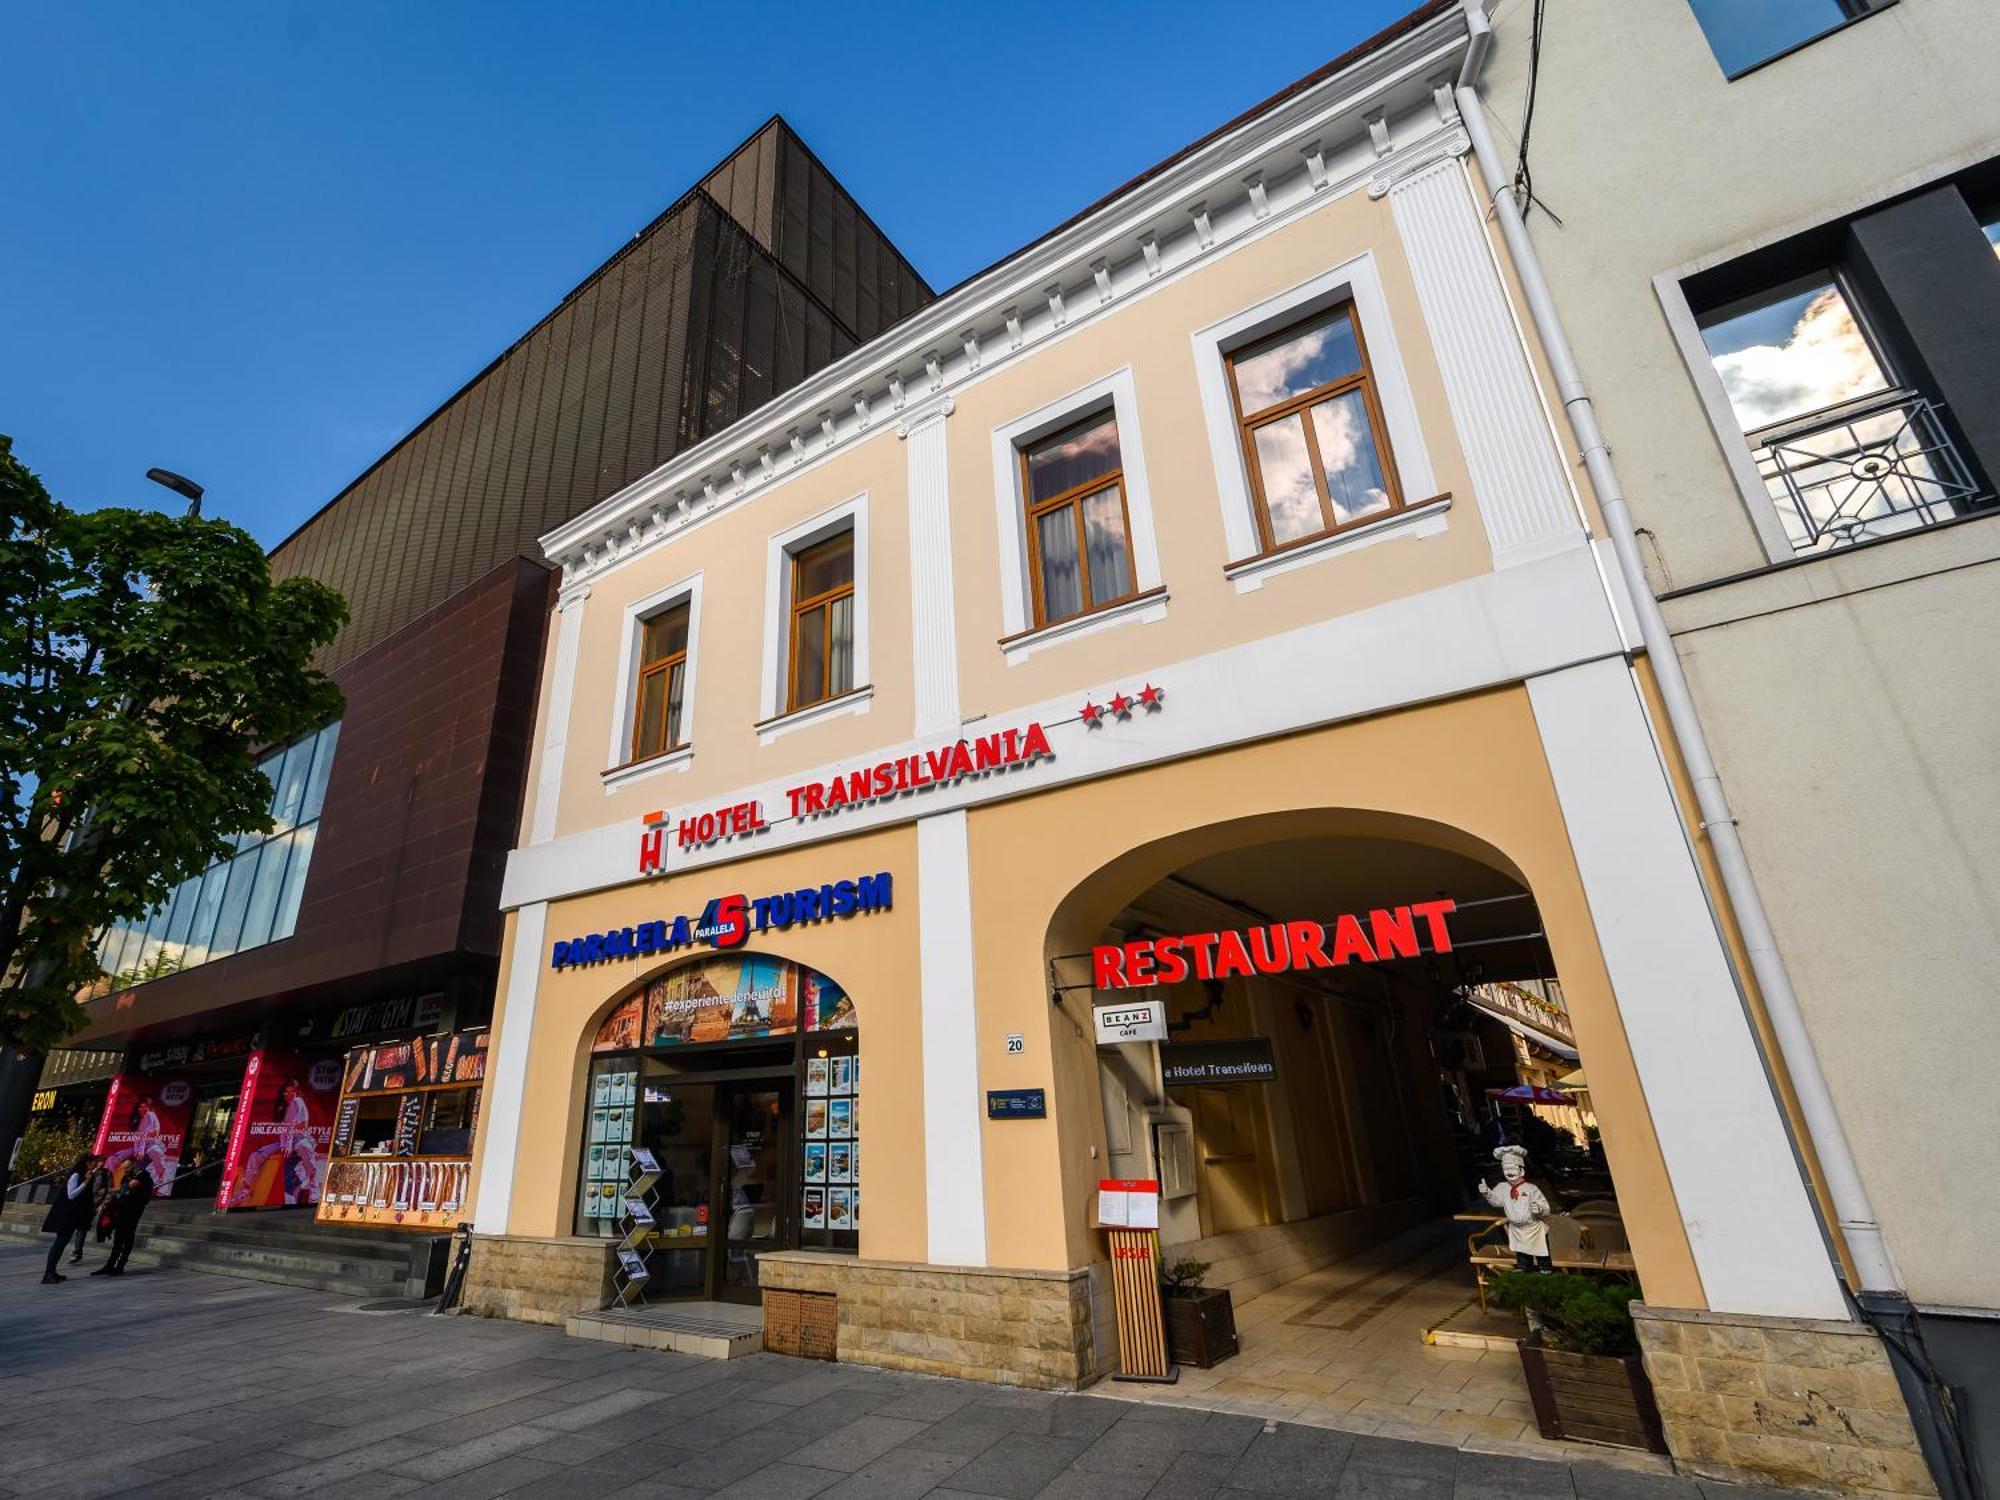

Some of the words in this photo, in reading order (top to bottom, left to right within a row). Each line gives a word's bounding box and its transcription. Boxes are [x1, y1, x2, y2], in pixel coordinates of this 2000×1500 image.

[678, 800, 765, 848] HOTEL
[786, 722, 1052, 818] TRANSILVANIA
[552, 915, 693, 968] PARALELA
[751, 871, 893, 929] TURISM
[695, 922, 735, 939] PARALELA
[1092, 899, 1456, 990] RESTAURANT
[1106, 1012, 1149, 1024] BEANZ
[1008, 1039, 1023, 1052] 20
[1173, 1064, 1206, 1077] Hotel
[308, 1126, 332, 1135] STYLE
